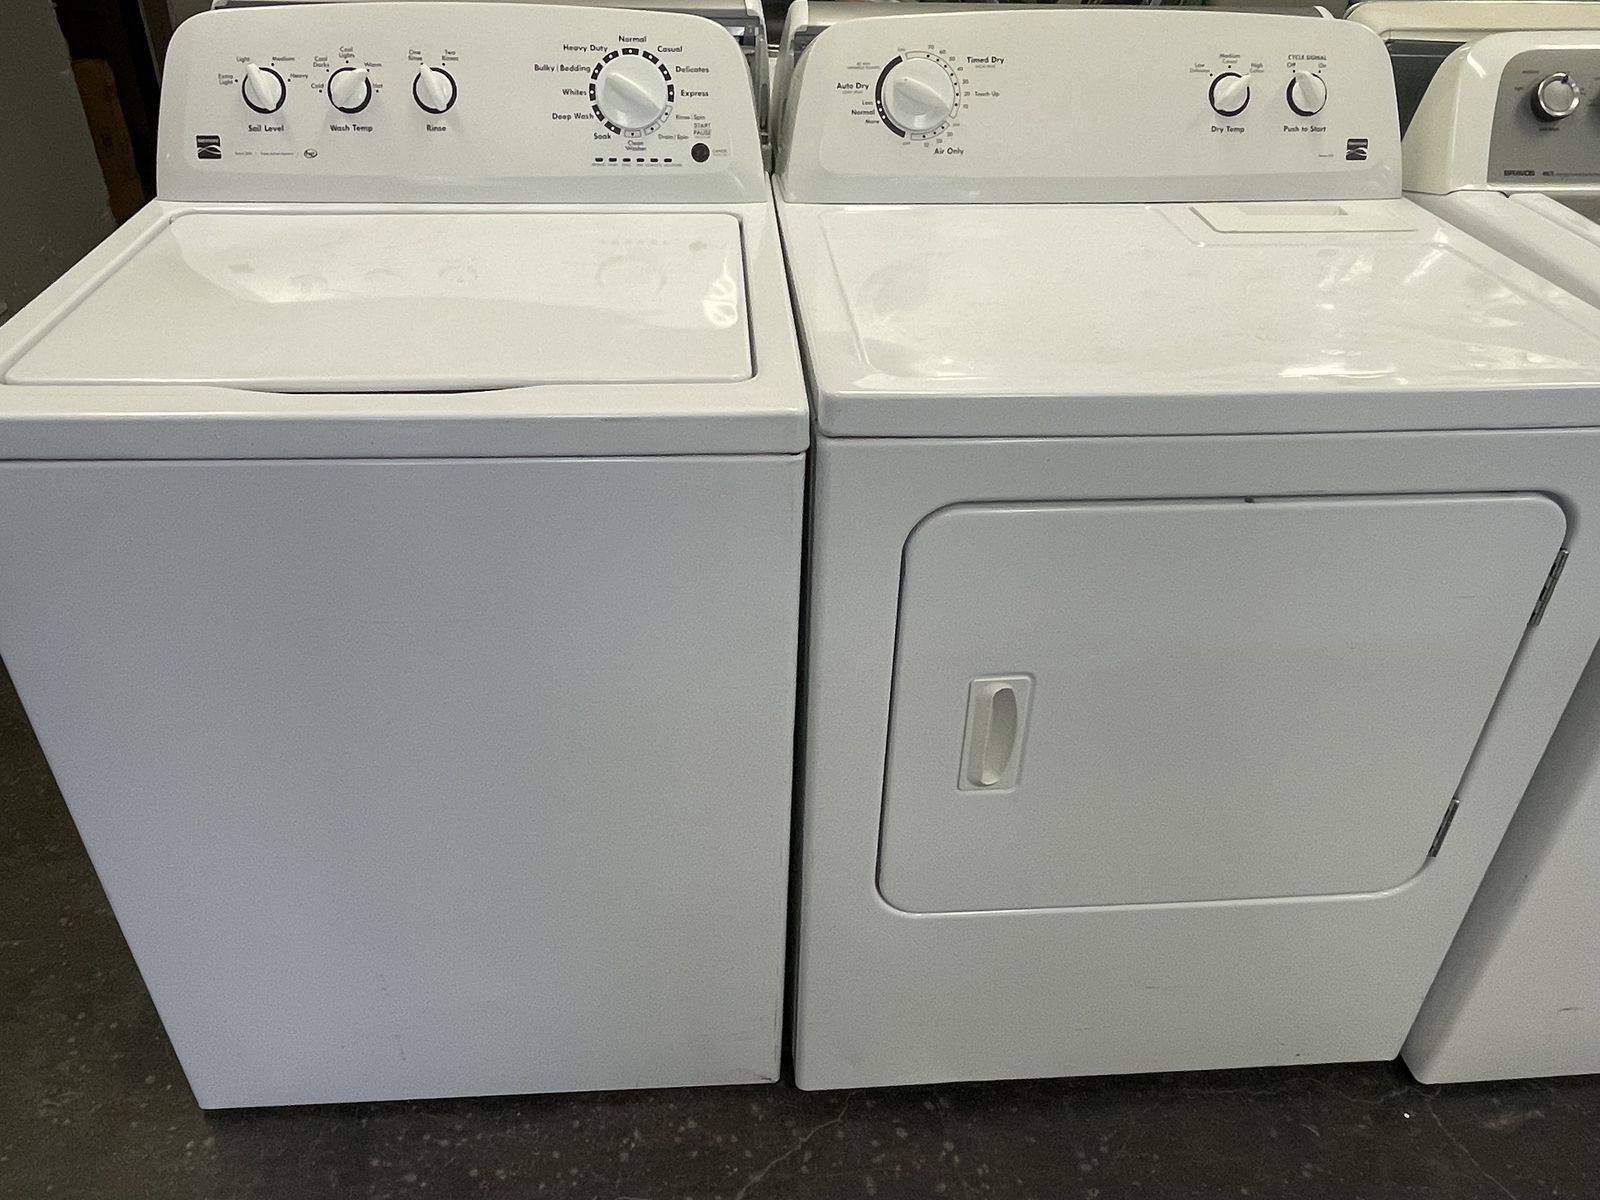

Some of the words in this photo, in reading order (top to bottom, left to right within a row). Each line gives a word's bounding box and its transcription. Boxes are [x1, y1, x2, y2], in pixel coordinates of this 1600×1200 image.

[618, 35, 647, 43] Normal
[563, 44, 587, 52] Heavy
[589, 44, 608, 53] Duty
[657, 45, 683, 53] Casual
[991, 56, 1005, 64] Dry
[534, 64, 555, 72] Bulky
[560, 64, 591, 73] Bedding
[836, 82, 854, 90] Auto
[855, 82, 870, 90] Dry
[562, 88, 587, 96] Whites
[680, 90, 709, 98] Express
[552, 112, 572, 120] Deep
[574, 112, 594, 120] Wash
[248, 124, 262, 132] Soil
[264, 124, 285, 132] Level
[330, 124, 350, 132] Wash
[352, 124, 373, 133] Temp
[593, 132, 611, 140] Soak
[947, 147, 965, 155] Only
